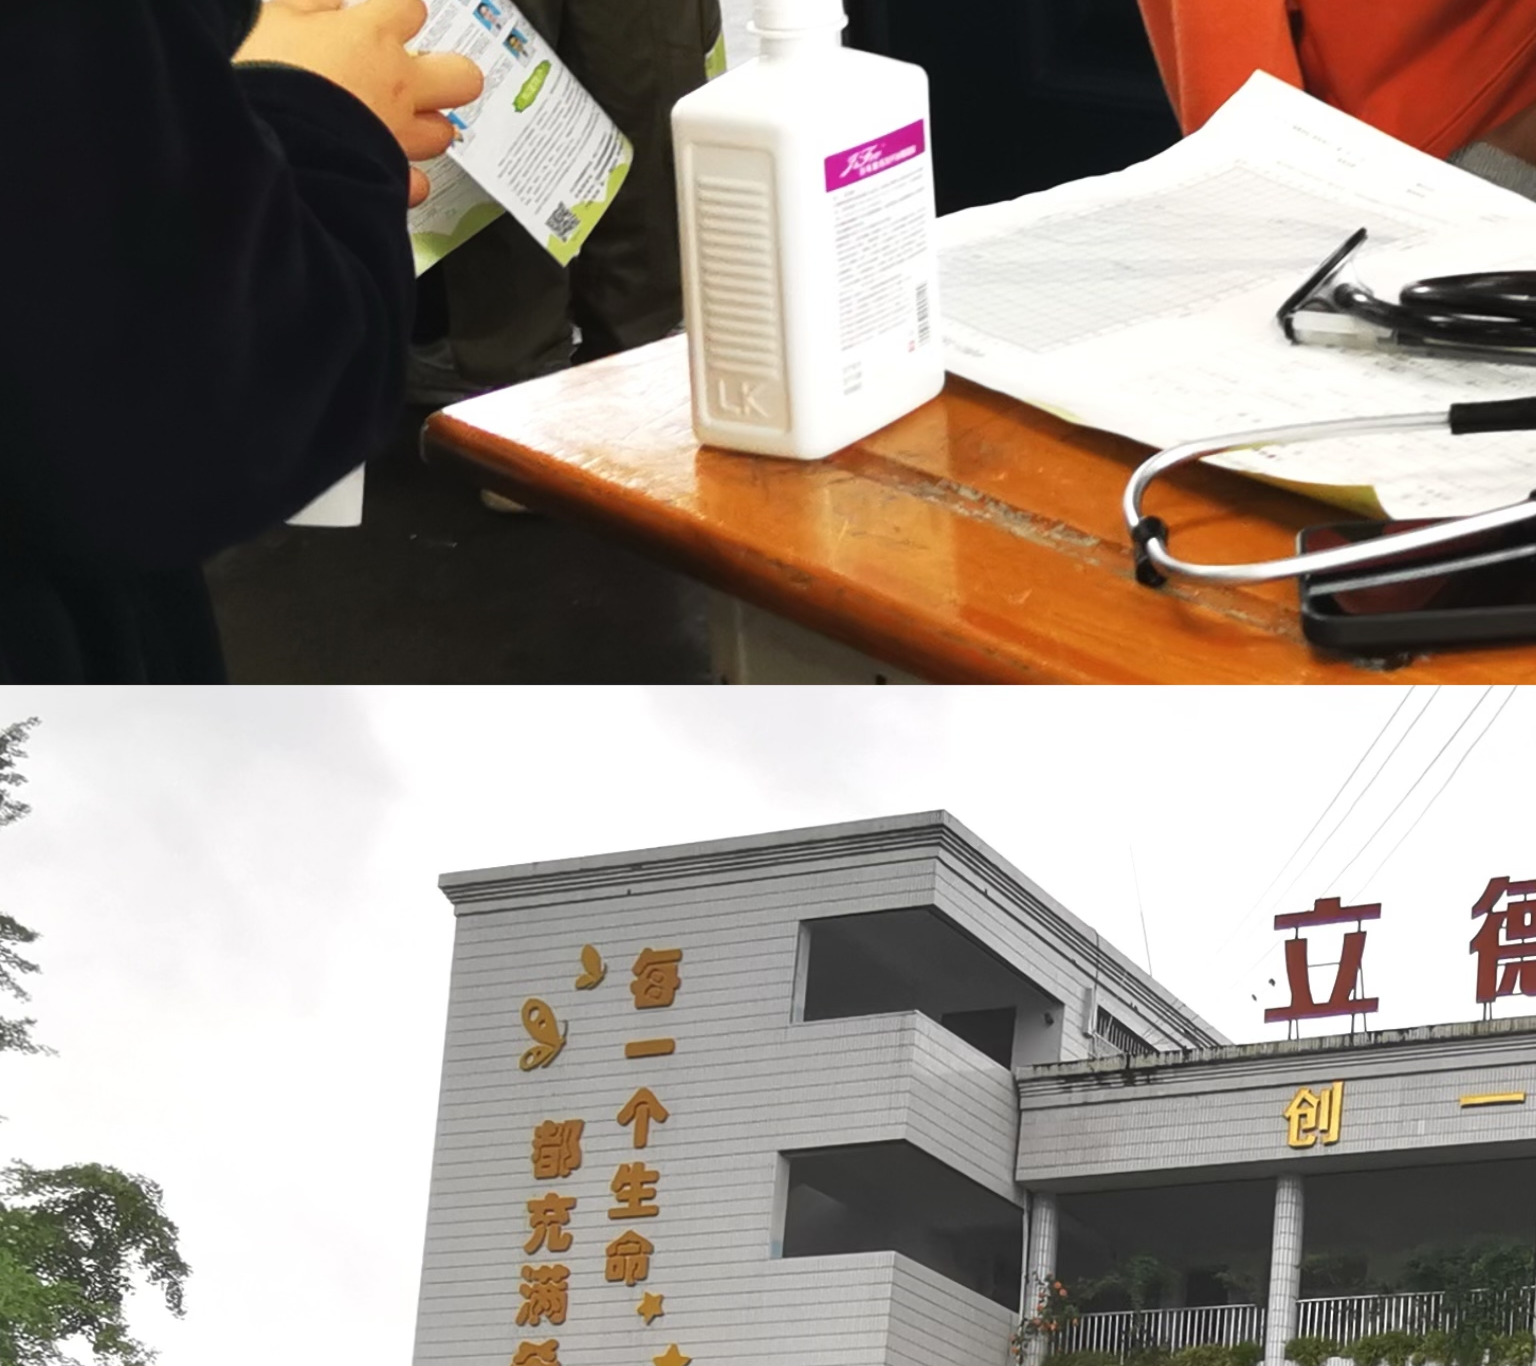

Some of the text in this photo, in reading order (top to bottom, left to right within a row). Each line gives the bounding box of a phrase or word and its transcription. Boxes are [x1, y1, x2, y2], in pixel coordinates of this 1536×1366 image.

[604, 946, 683, 1287] 每一个生命
